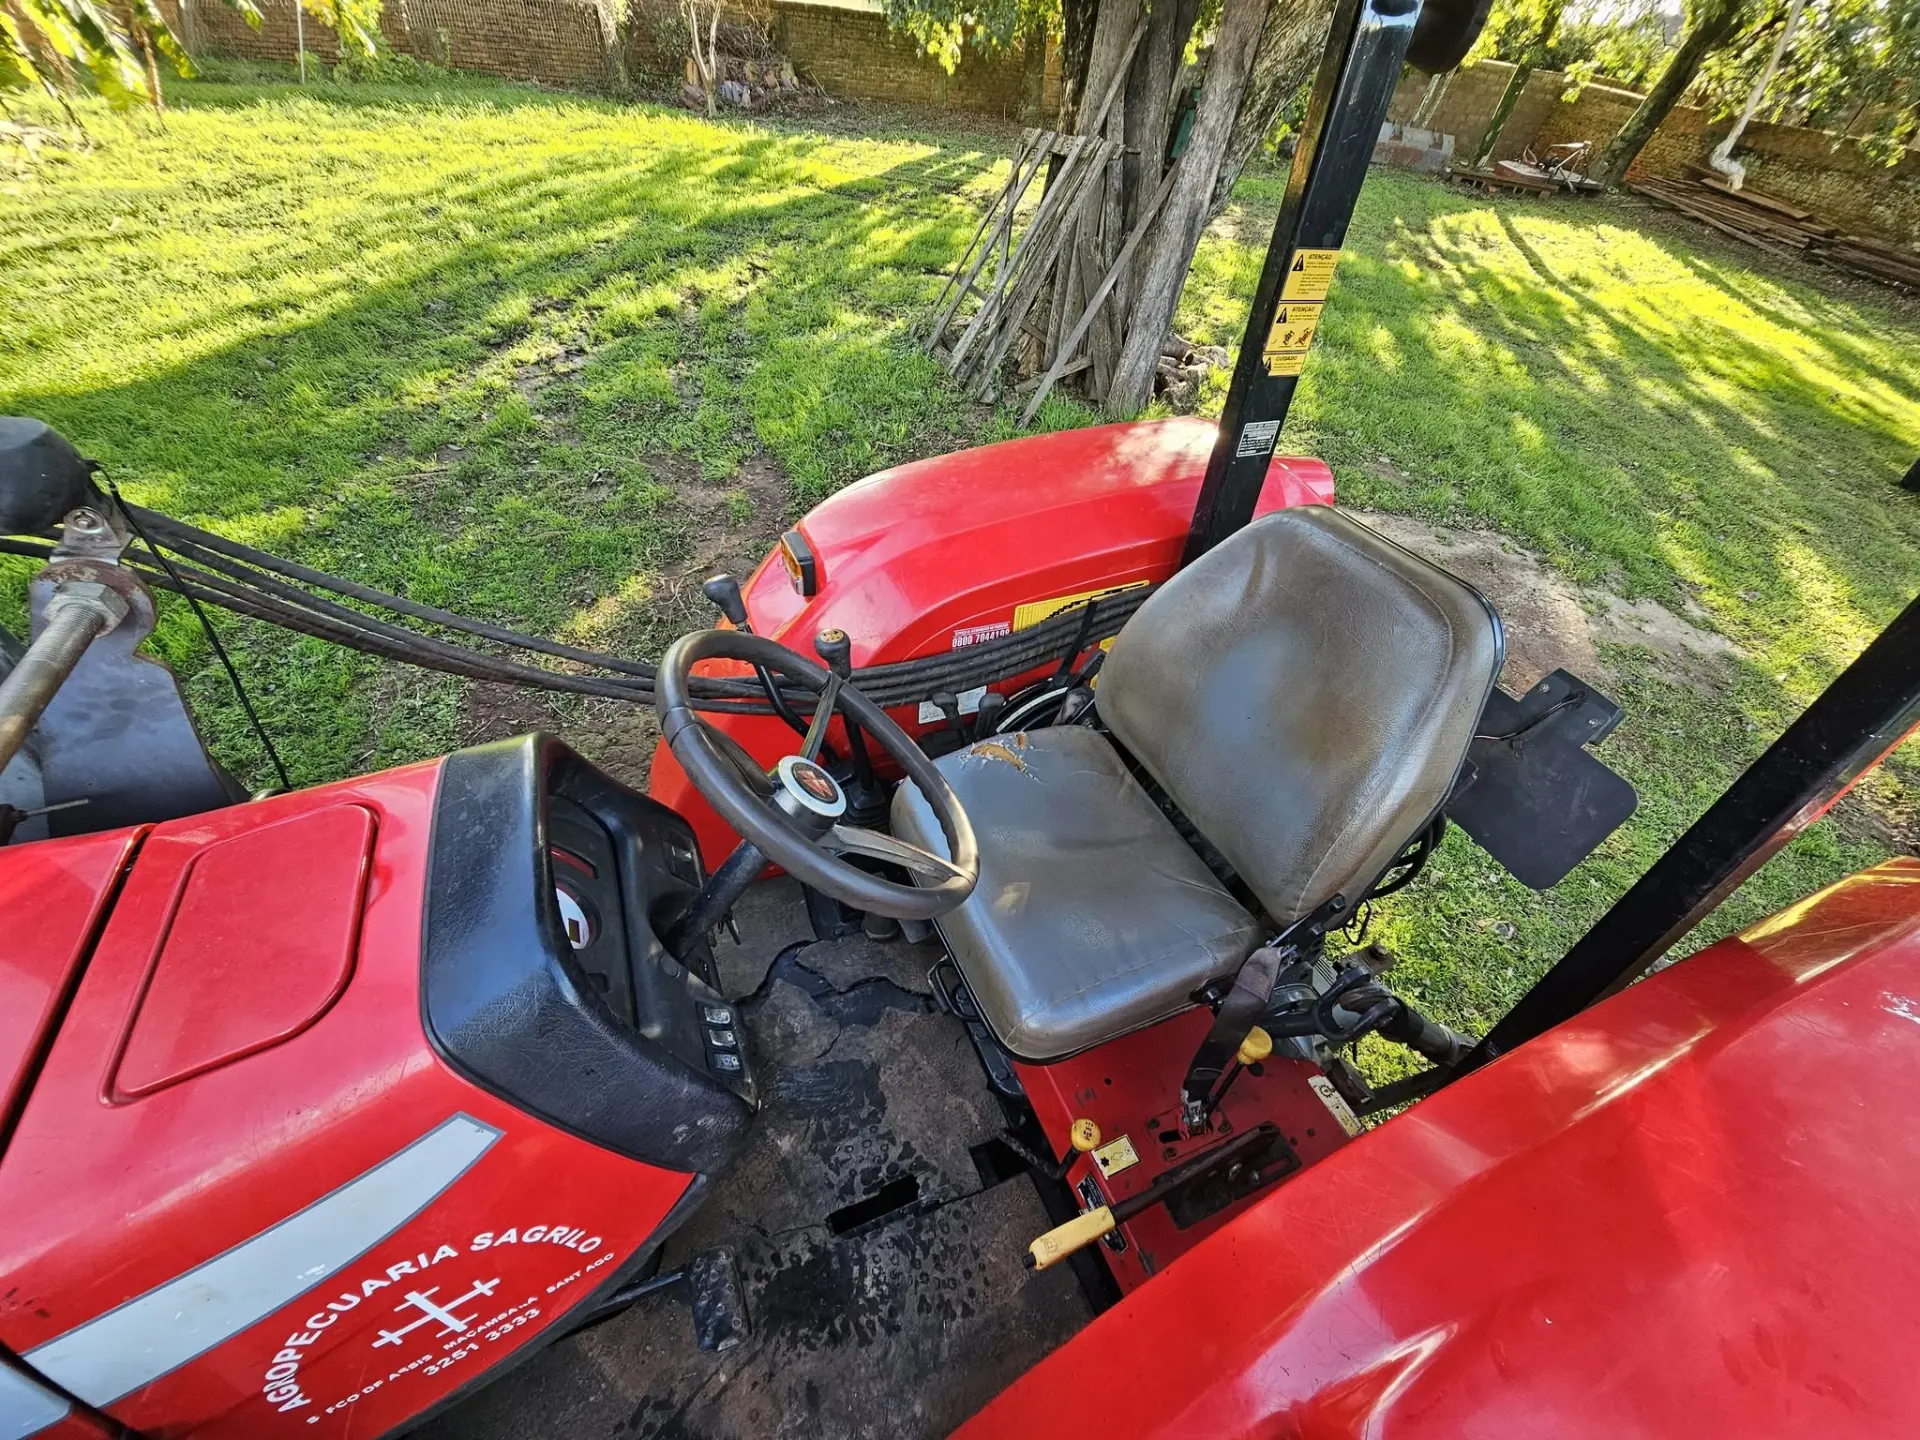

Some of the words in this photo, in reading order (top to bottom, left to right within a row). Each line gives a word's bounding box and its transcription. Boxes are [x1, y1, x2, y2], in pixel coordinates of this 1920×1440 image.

[952, 634, 974, 648] 0800
[262, 1244, 459, 1413] AGROPECUARIA
[469, 1225, 603, 1254] SAGRILO
[422, 1342, 481, 1377] 3251
[484, 1307, 541, 1342] 3333
